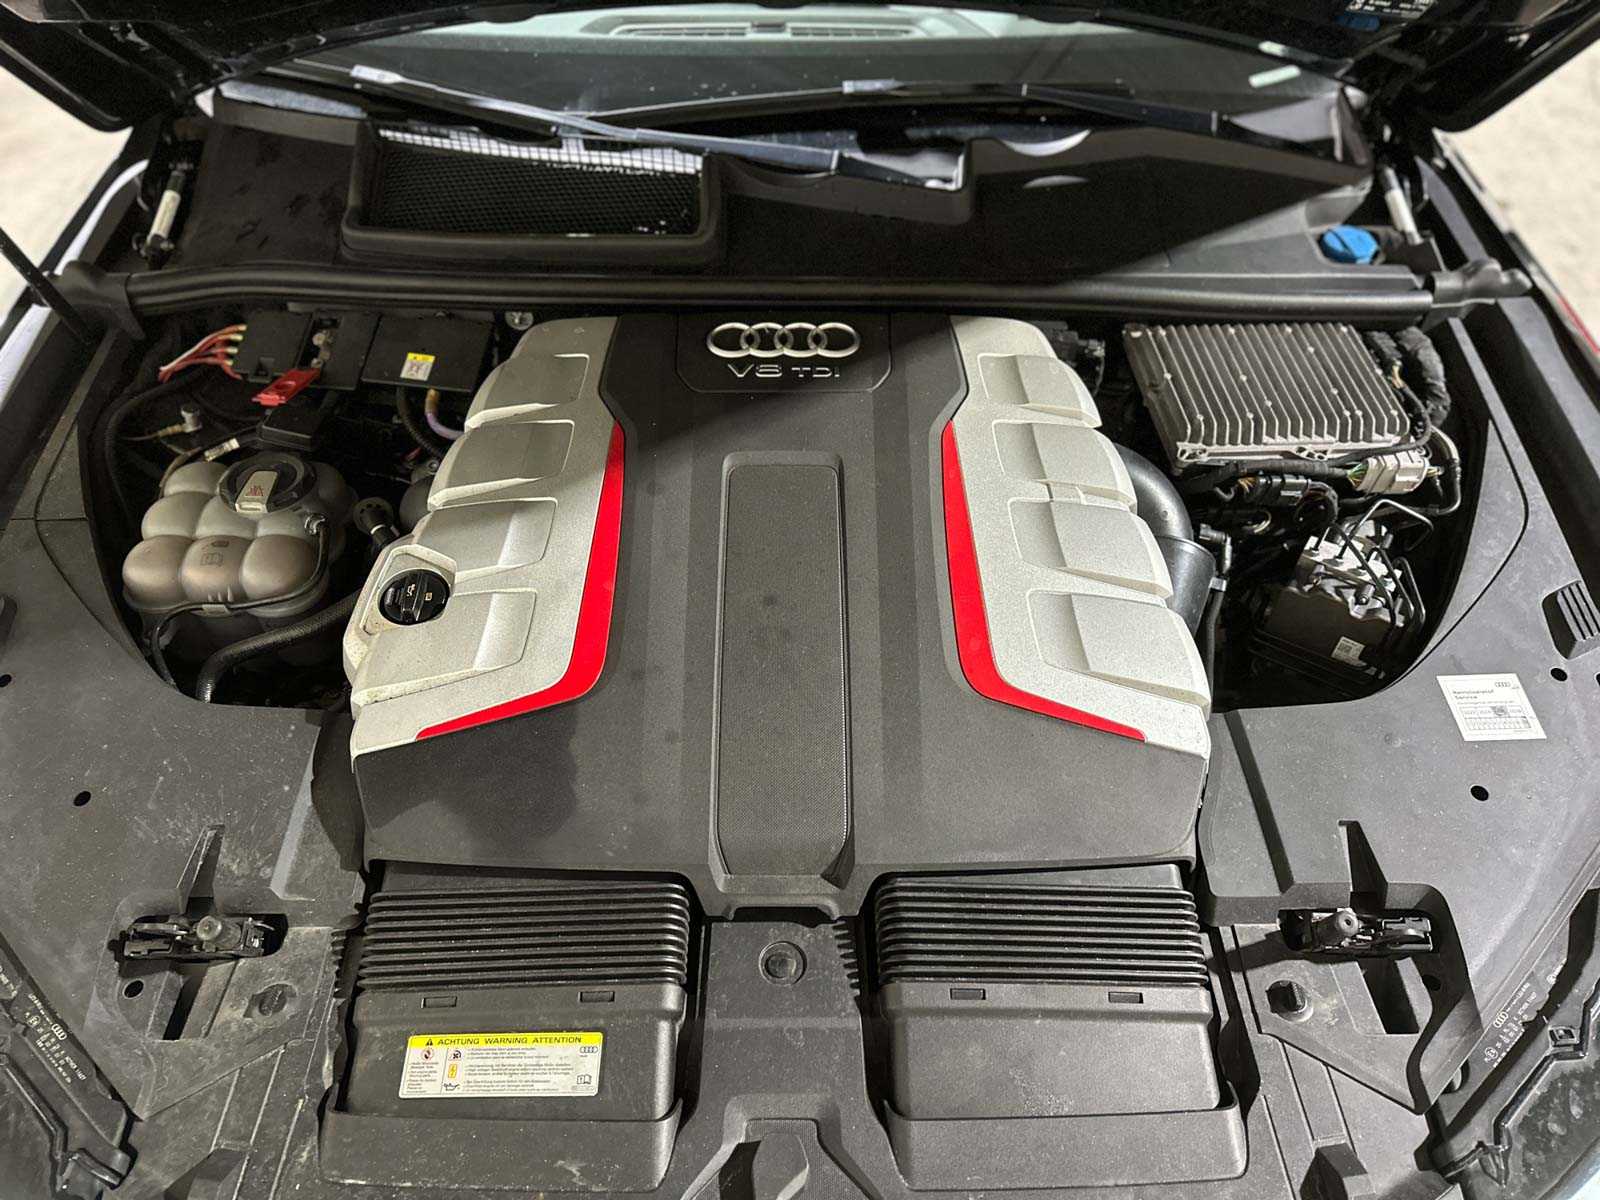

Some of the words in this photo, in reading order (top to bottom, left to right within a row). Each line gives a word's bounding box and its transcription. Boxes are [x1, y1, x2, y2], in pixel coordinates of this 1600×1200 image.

[727, 363, 783, 378] V8
[791, 366, 841, 378] TDI
[437, 1038, 480, 1046] ACHTUNG
[484, 1037, 528, 1045] WARNING
[532, 1036, 582, 1044] ATTENTION
